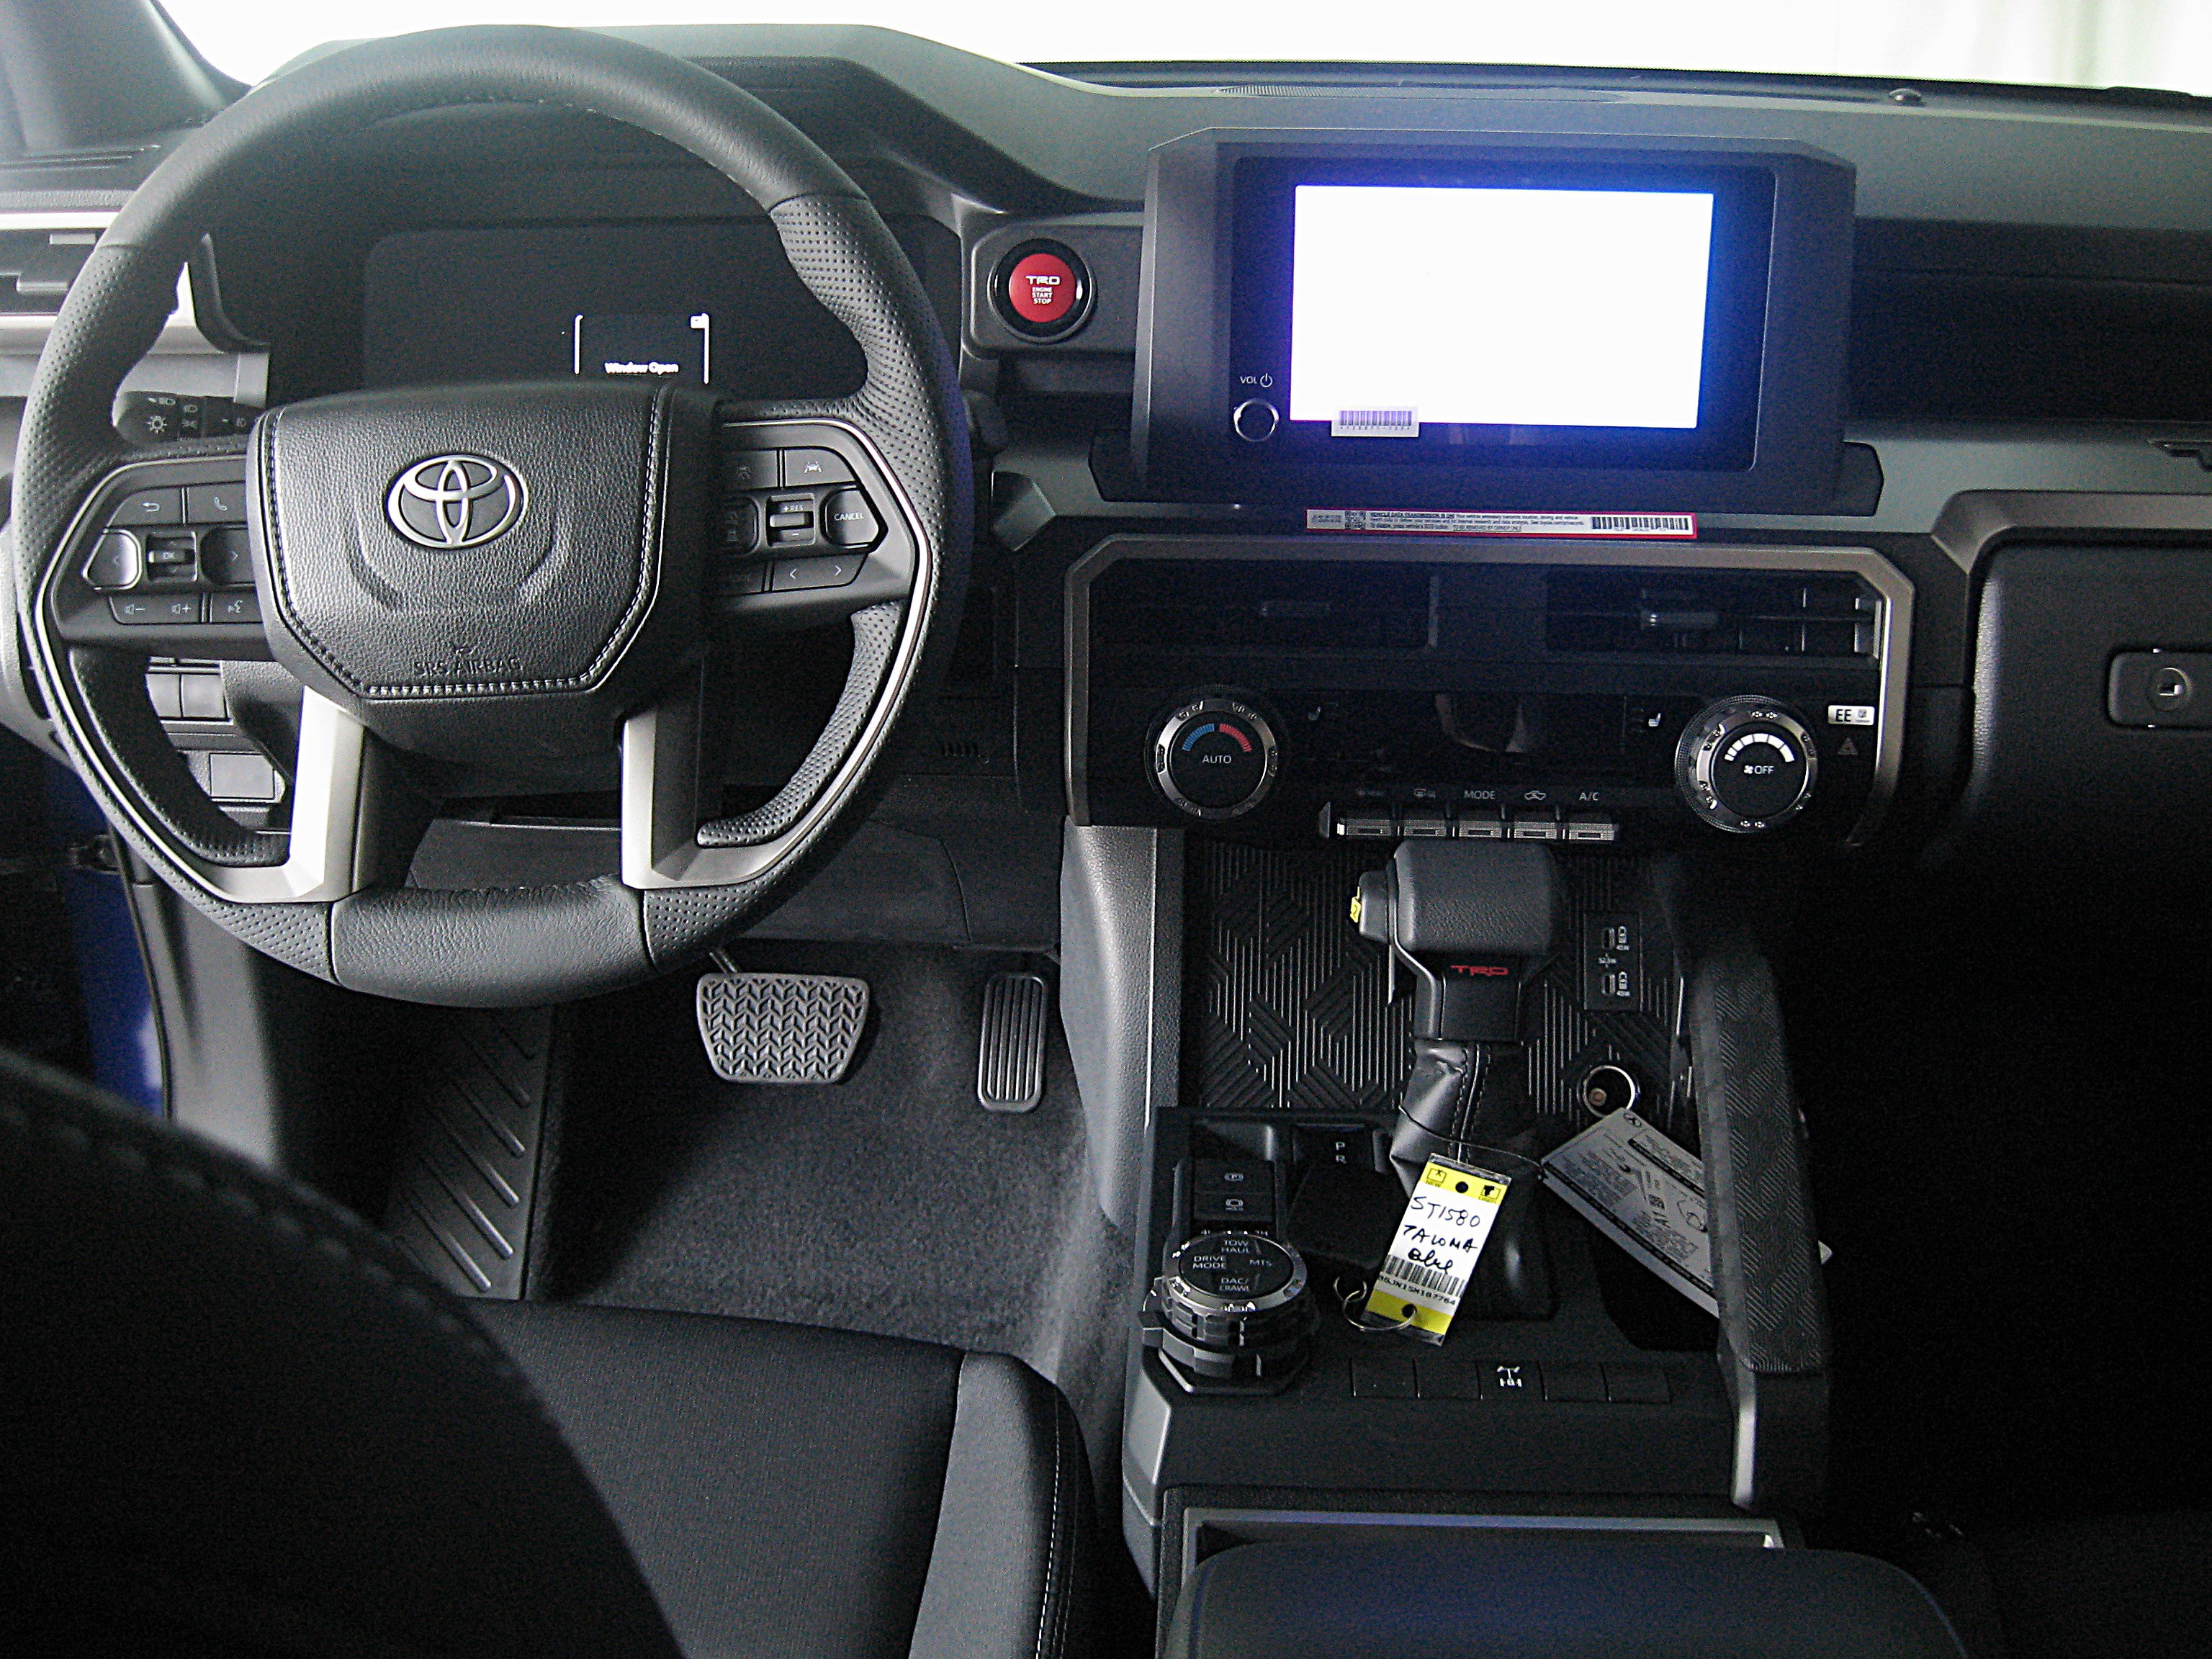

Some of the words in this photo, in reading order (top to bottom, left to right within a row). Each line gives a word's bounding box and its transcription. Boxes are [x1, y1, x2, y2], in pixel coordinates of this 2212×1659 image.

[1025, 275, 1061, 285] TRD
[603, 361, 648, 374] Window
[648, 361, 679, 376] Open
[1835, 709, 1852, 722] EE
[1202, 755, 1231, 764] AUTO
[1754, 765, 1774, 775] OFF
[1464, 790, 1496, 799] MODE
[1579, 792, 1599, 801] A/C
[1450, 965, 1509, 977] TRD
[1335, 1141, 1346, 1151] P
[1335, 1154, 1346, 1164] R
[1411, 1196, 1480, 1228] ST1580
